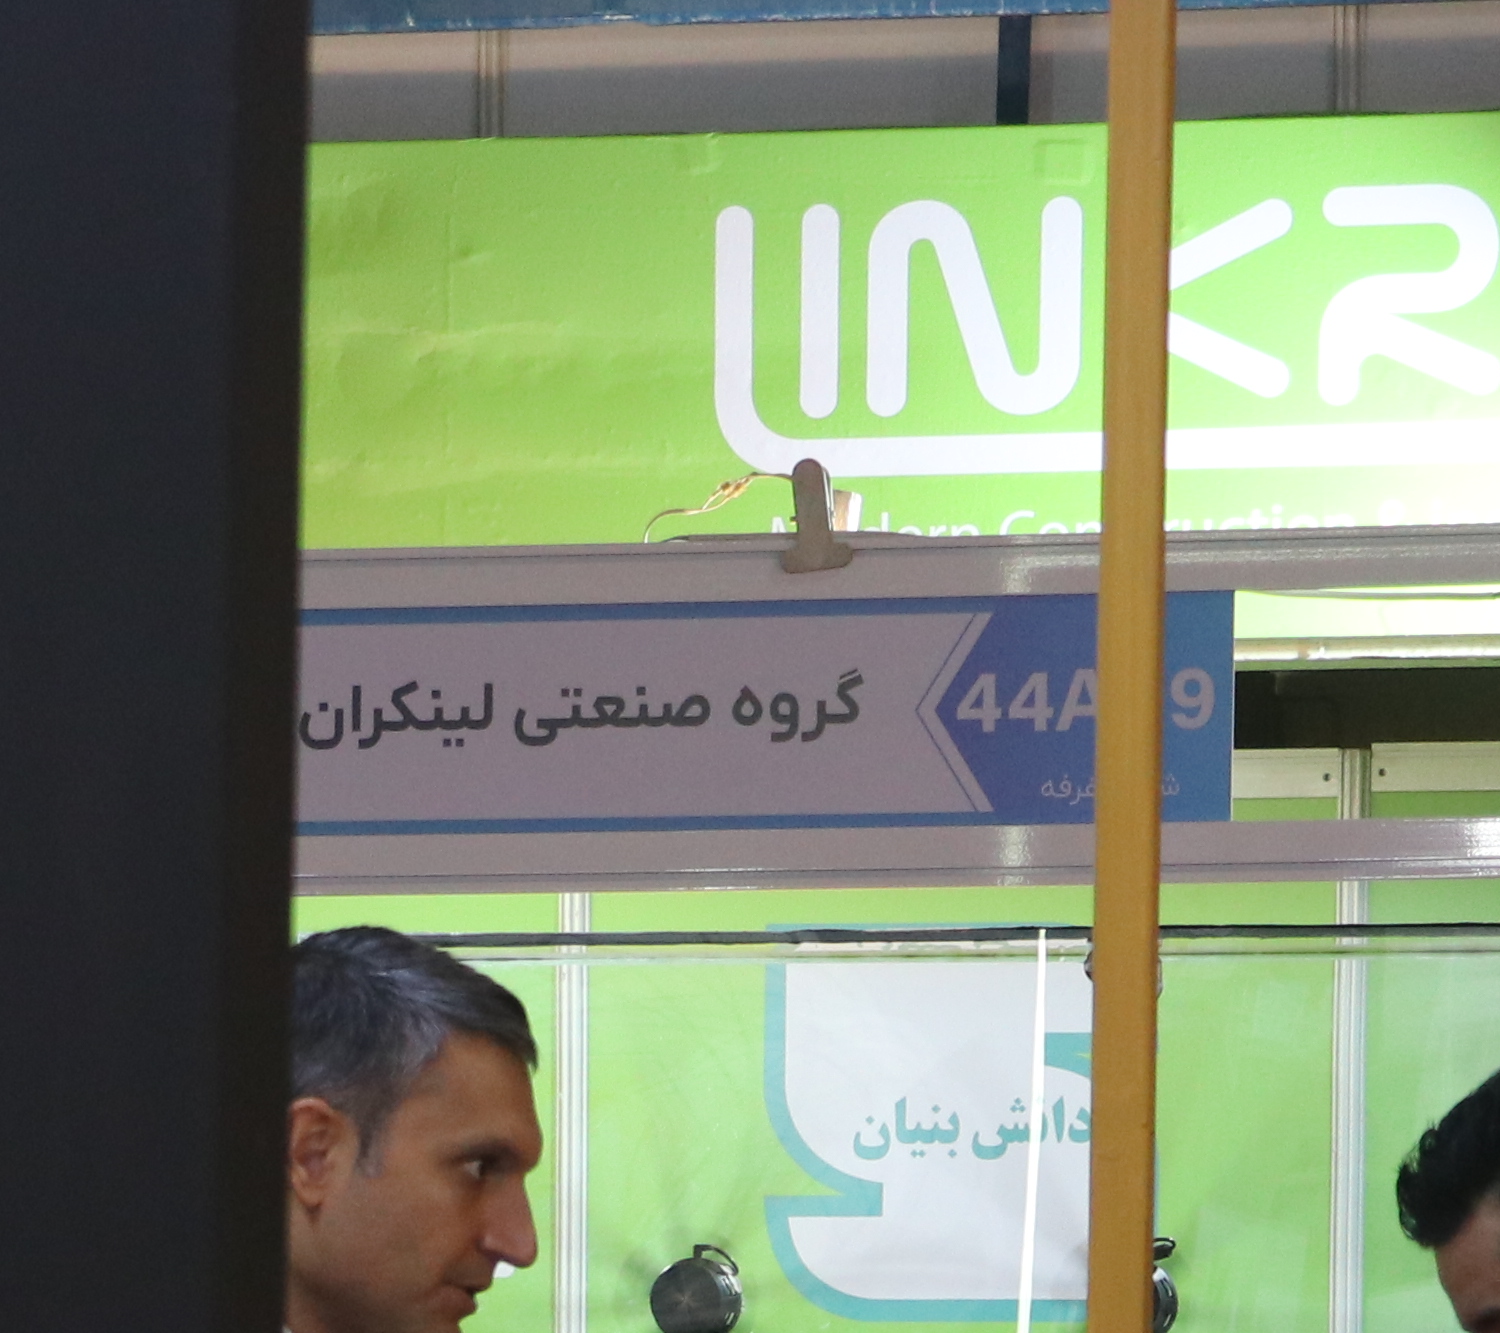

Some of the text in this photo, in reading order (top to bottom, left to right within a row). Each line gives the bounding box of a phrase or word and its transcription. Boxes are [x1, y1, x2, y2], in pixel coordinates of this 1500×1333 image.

[299, 668, 864, 750] گروه صنعتی لینکران
[955, 667, 1216, 733] 44A9
[853, 1095, 961, 1161] بنیان
